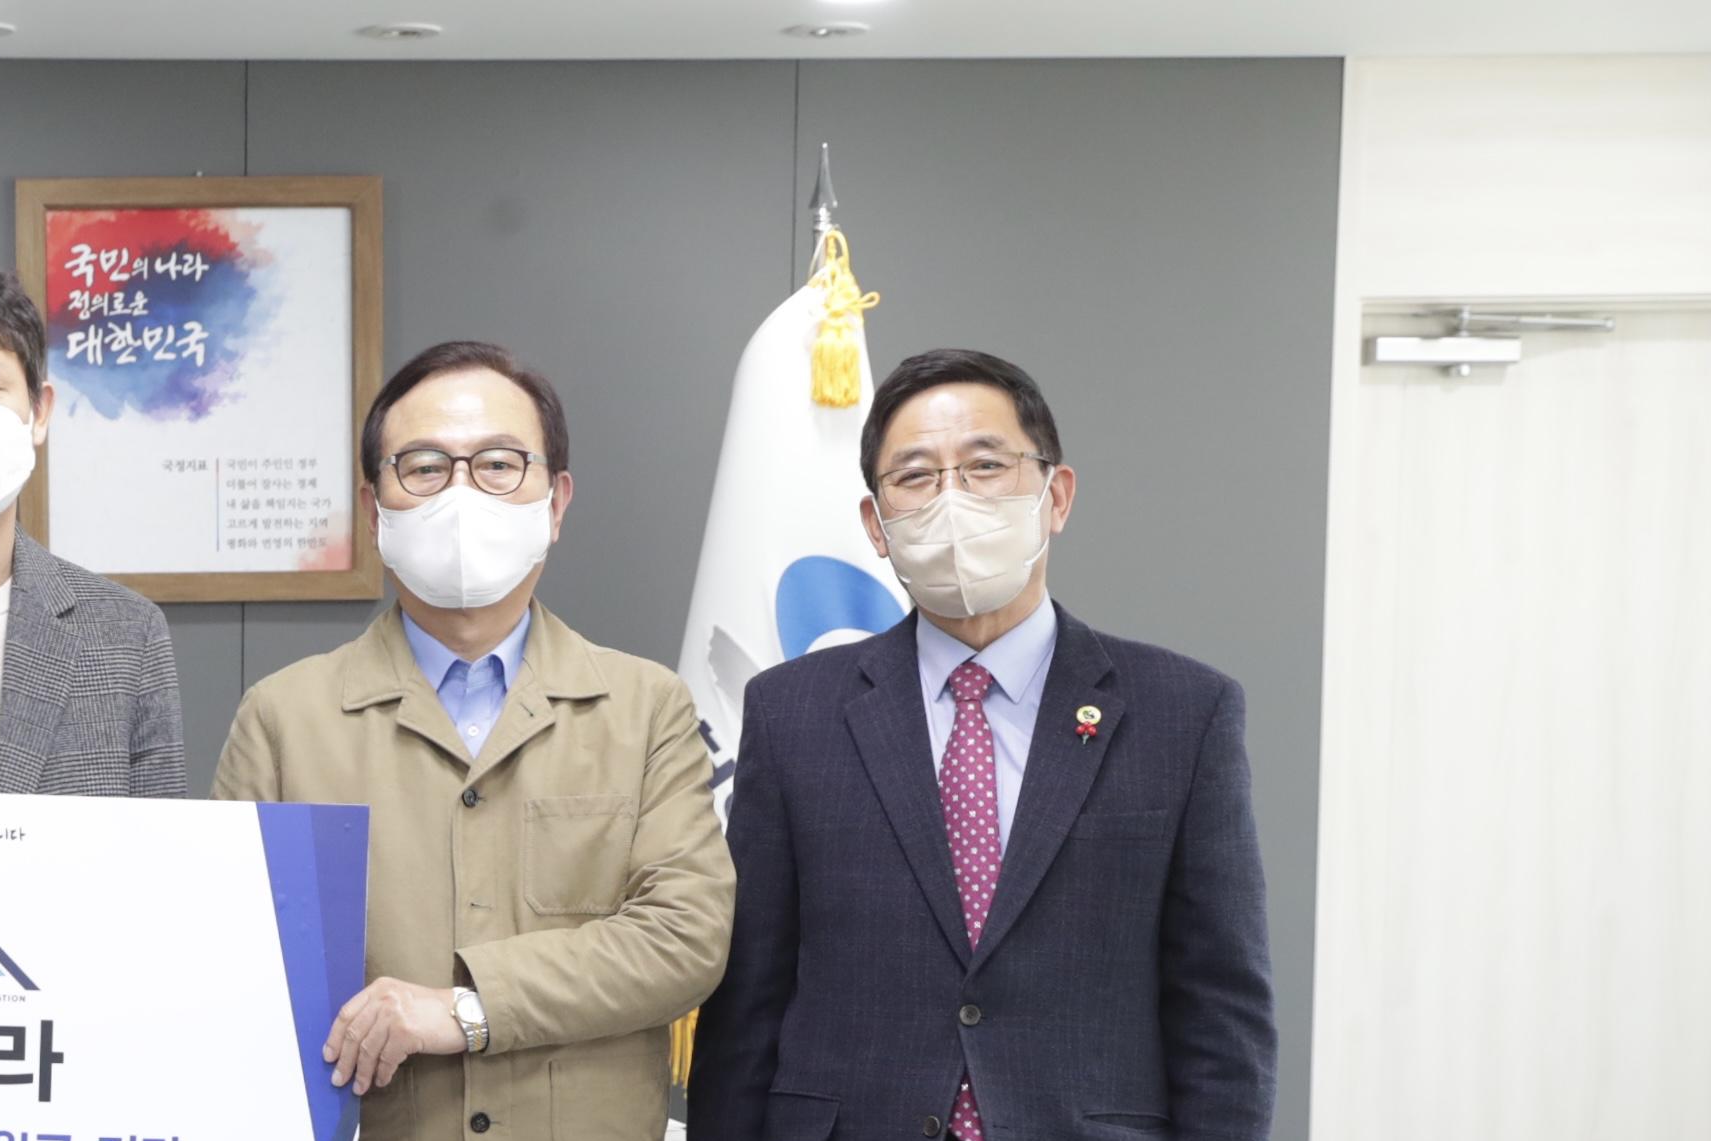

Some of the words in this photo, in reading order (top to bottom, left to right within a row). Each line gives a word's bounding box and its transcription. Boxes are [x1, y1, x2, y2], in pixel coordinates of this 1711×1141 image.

[64, 243, 149, 287] 국민의
[154, 251, 209, 282] 나라
[68, 289, 149, 320] 정의로운
[66, 321, 209, 367] 대한민국
